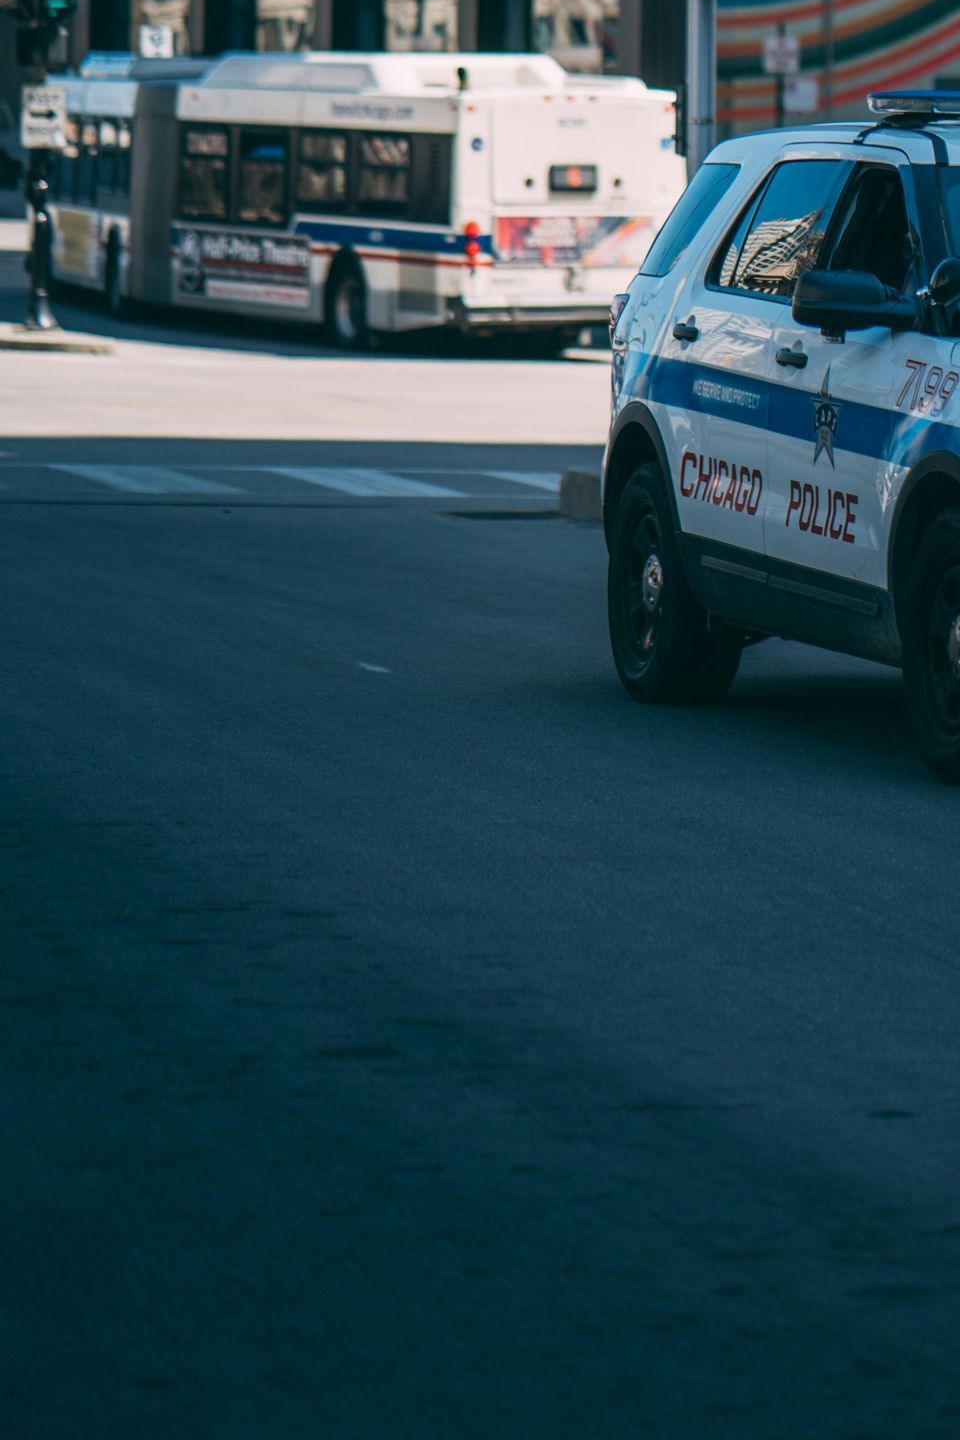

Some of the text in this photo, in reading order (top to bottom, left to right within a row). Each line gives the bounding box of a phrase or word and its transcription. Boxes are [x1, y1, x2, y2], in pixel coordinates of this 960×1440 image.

[702, 381, 721, 400] SERVE
[722, 386, 733, 403] AND
[734, 389, 760, 409] PROTECT
[896, 359, 960, 417] 7199
[680, 451, 858, 544] CHICAGO POLICE
